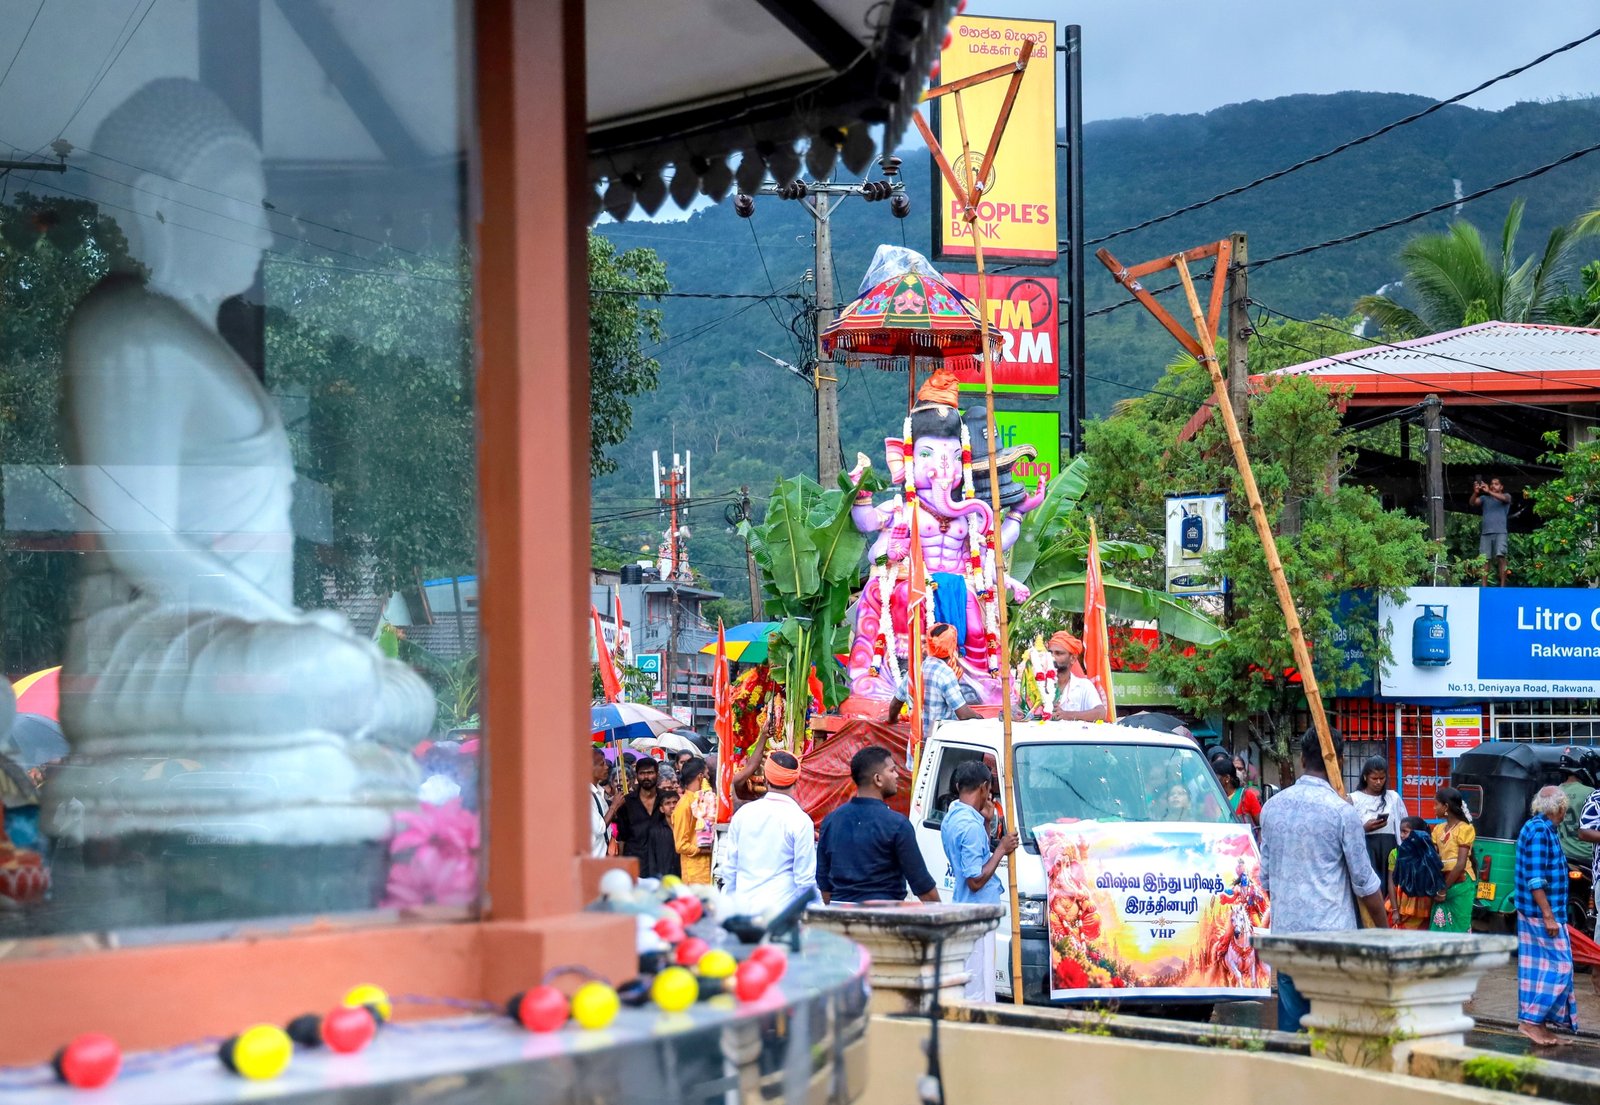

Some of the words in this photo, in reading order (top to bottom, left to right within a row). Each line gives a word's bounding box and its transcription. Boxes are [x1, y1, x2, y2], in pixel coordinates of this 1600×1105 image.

[969, 42, 1011, 55] மக்கள்
[951, 201, 1050, 225] POPLE'S
[952, 221, 1001, 240] BANK
[970, 298, 1033, 330] TM
[973, 331, 1053, 363] RM
[1518, 606, 1582, 631] Litro
[1531, 643, 1600, 657] Rakwana
[1448, 683, 1476, 693] No.13,
[1478, 683, 1520, 693] Deniyaya
[1523, 684, 1549, 693] Road,
[1552, 684, 1596, 693] Rakwana.
[1404, 774, 1444, 787] SERVO
[1096, 872, 1140, 892] விஷ்வ
[1143, 872, 1182, 894] இந்து
[1183, 872, 1225, 895] பரிஷத்
[1124, 896, 1199, 915] இரத்தினபுரி
[1150, 928, 1176, 938] VHP
